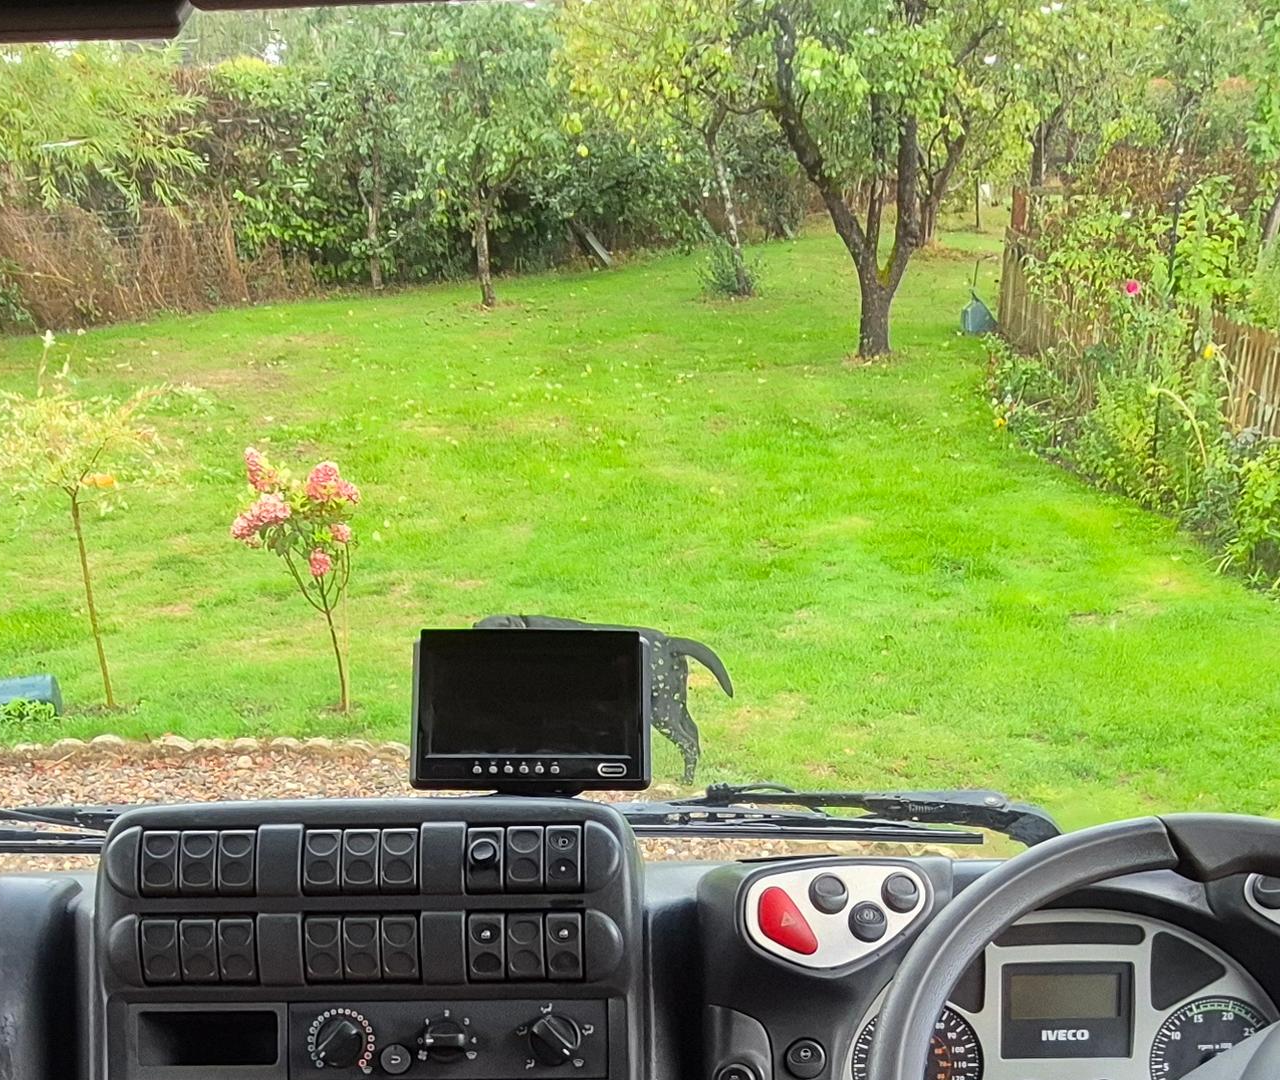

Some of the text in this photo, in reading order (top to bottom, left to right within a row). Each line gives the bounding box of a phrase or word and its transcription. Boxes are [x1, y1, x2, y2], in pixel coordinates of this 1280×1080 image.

[1193, 1014, 1204, 1023] 15
[1222, 1012, 1234, 1021] 20
[1041, 1029, 1090, 1041] IVECO
[1171, 1031, 1181, 1040] 10
[1243, 1027, 1255, 1037] 25
[951, 1046, 965, 1054] 100
[1163, 1062, 1170, 1071] 5
